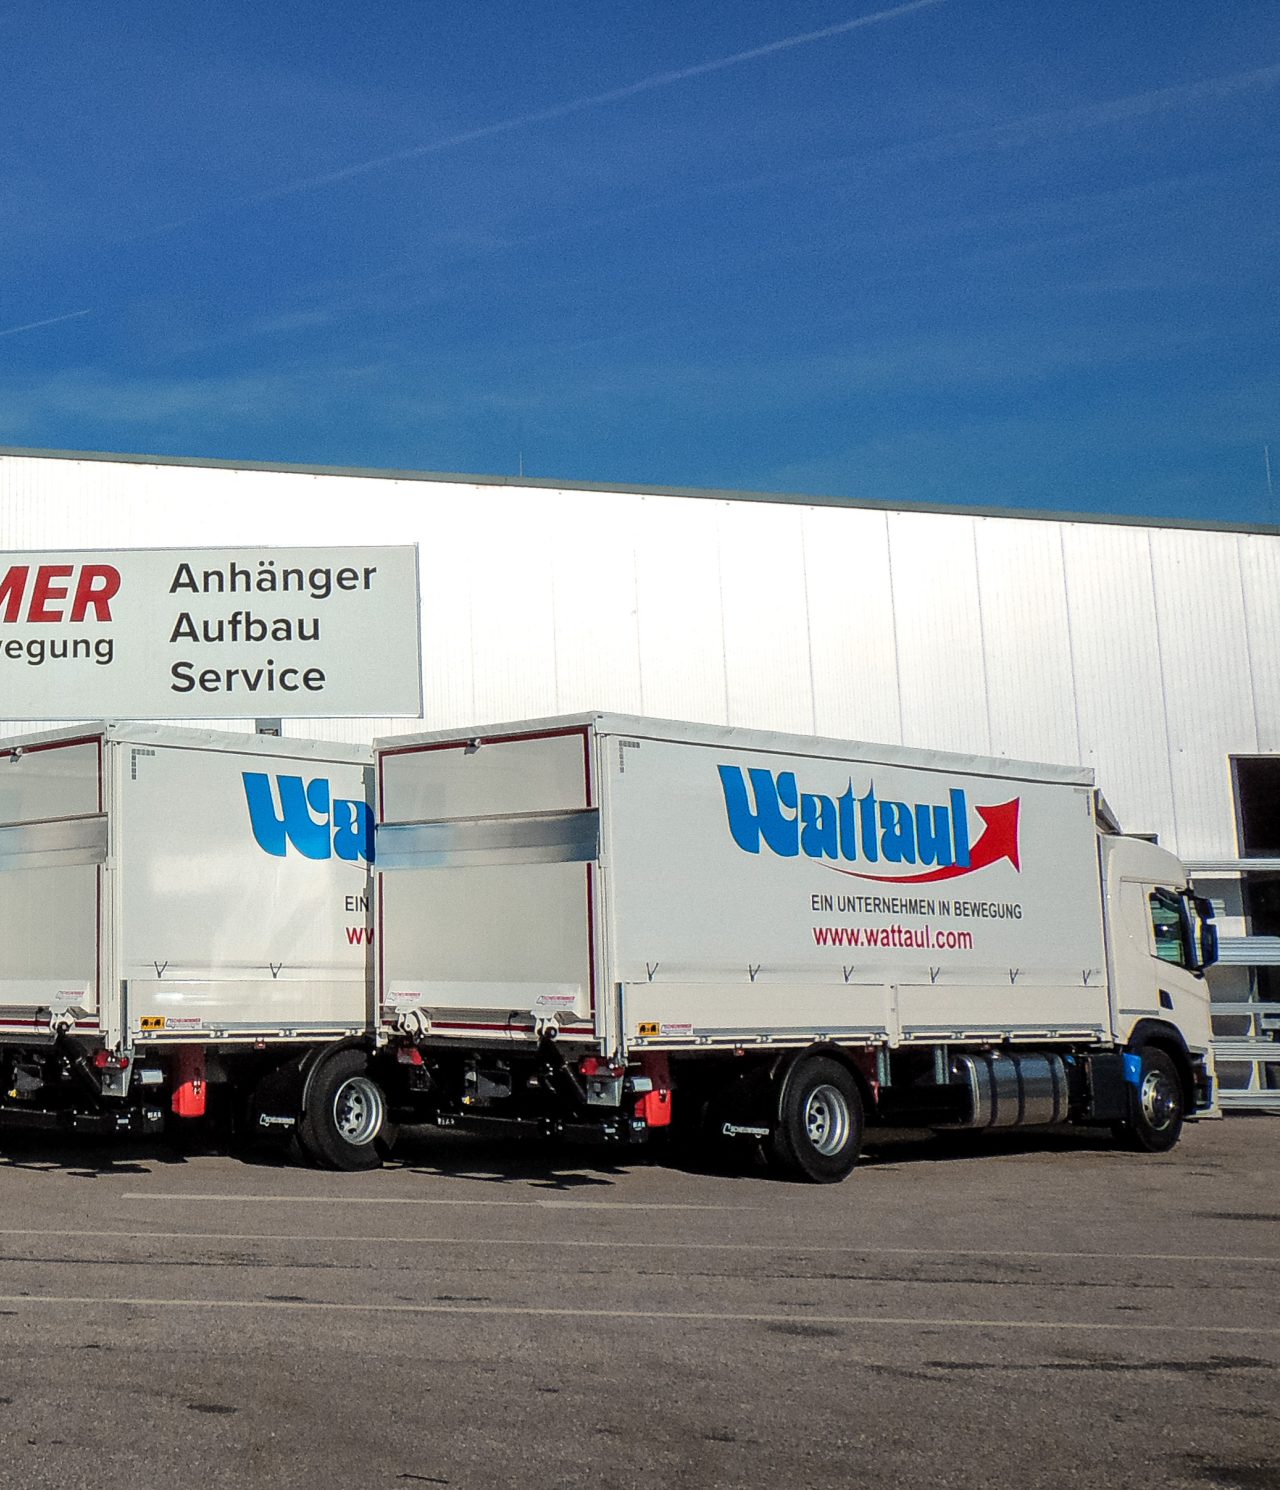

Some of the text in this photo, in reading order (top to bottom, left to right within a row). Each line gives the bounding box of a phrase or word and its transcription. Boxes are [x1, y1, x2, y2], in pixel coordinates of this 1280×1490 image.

[169, 560, 377, 600] Anhänger
[169, 611, 320, 643] Aufbau
[170, 658, 326, 693] Service
[717, 764, 971, 868] Wattaul
[345, 896, 369, 912] EIN
[811, 894, 1023, 920] EIN UNTERNEHMEN IN BEWEGUNG
[813, 924, 974, 950] www.wattaul.com
